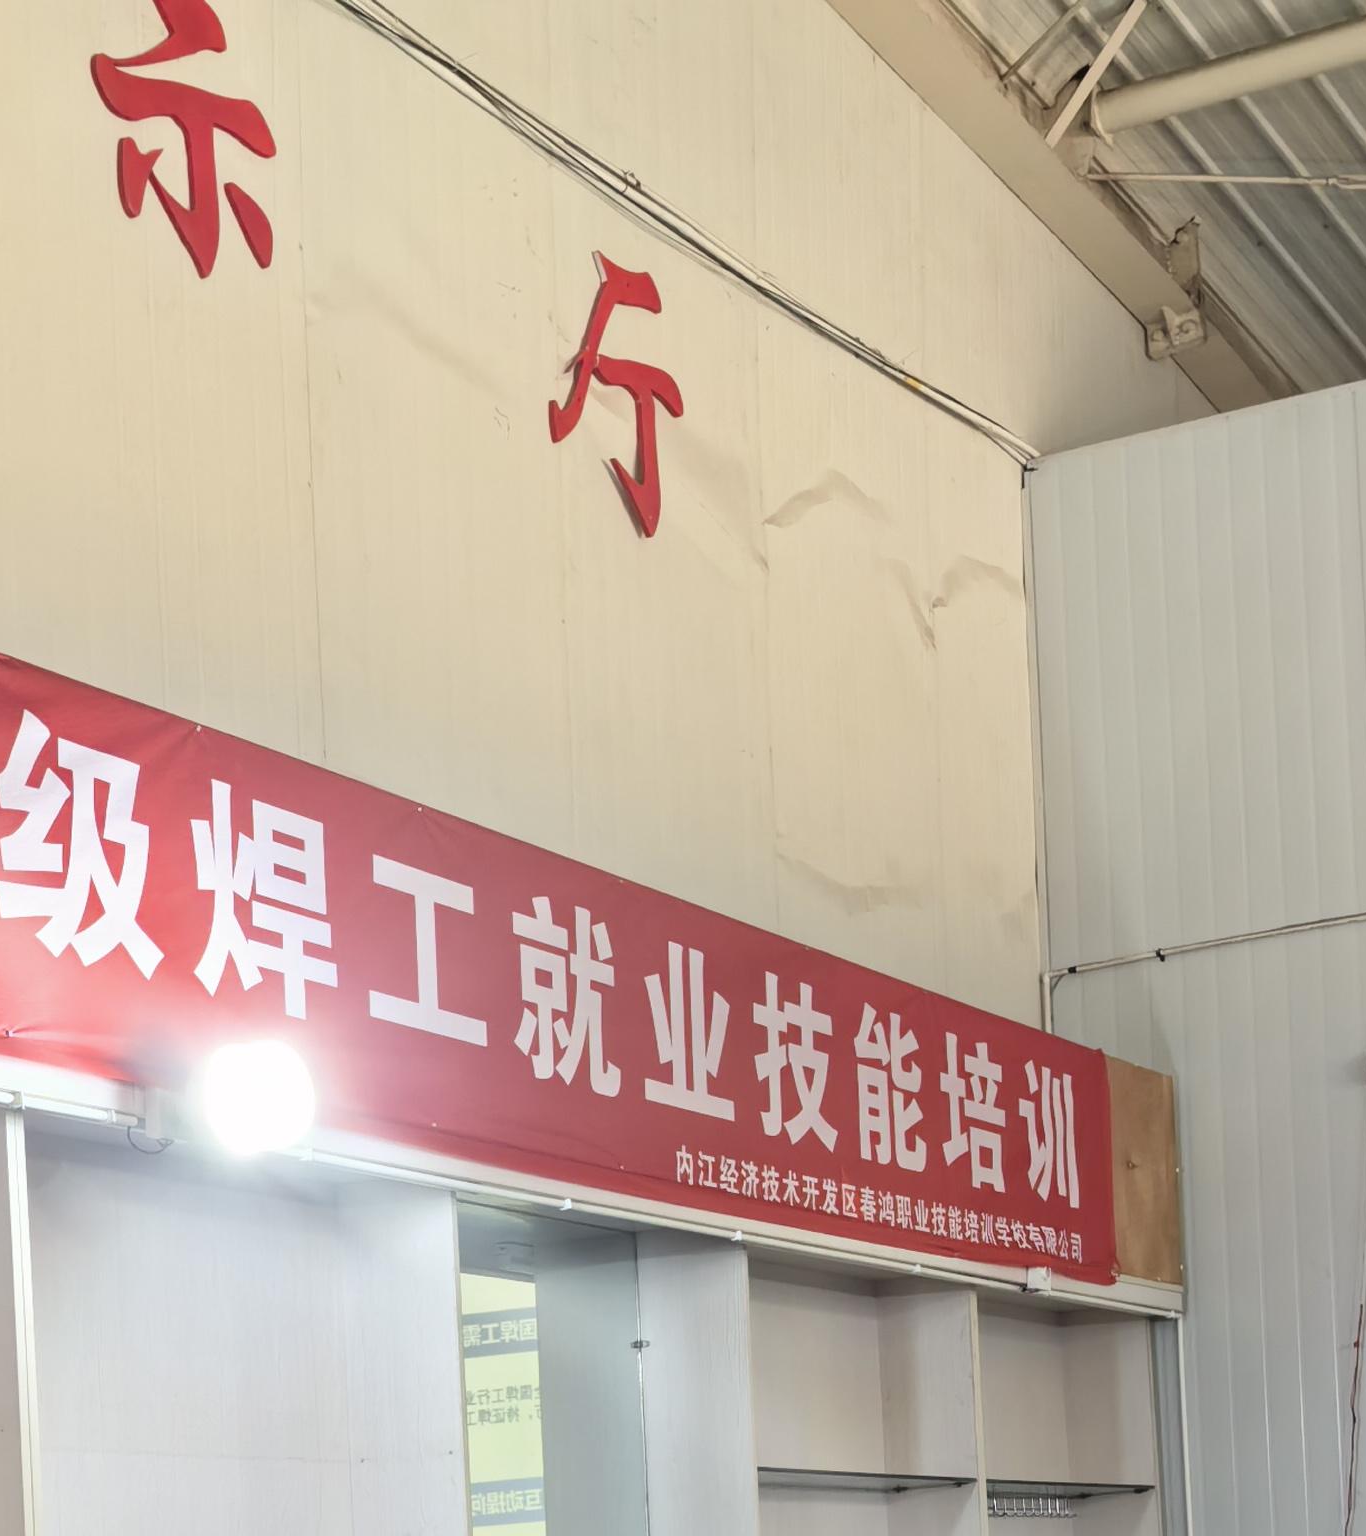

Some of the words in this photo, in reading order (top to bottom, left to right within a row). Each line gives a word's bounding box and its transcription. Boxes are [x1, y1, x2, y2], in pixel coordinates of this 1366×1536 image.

[676, 1143, 1083, 1264] 内江经济技术开发区春鸿职业技能培训学校有限公司
